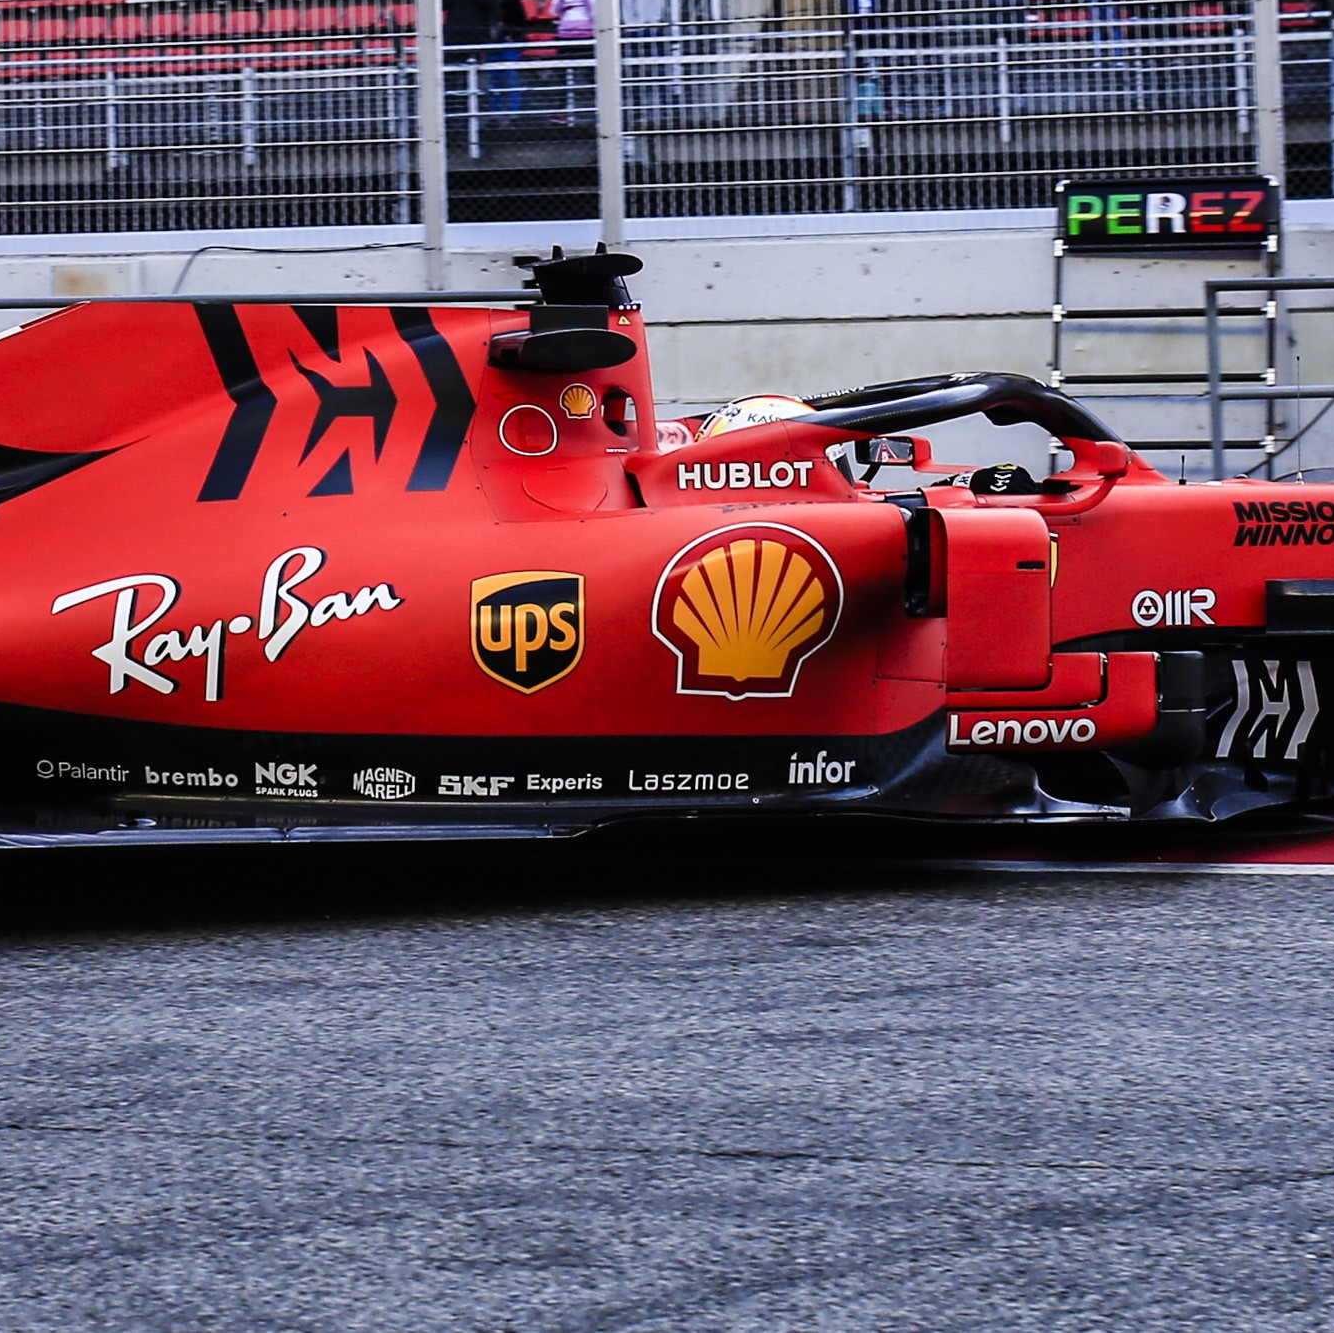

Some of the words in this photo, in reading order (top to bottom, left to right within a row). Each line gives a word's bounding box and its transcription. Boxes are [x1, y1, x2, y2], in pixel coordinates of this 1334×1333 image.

[1067, 190, 1266, 236] PEREZ
[677, 460, 815, 491] HUBLOT
[479, 602, 578, 673] ups
[947, 713, 1097, 747] Lenovo
[58, 762, 131, 784] Palantir
[144, 765, 239, 788] brembo
[254, 762, 319, 787] NGK
[788, 750, 857, 785] infor
[437, 774, 515, 797] SKF
[526, 773, 603, 793] Experis
[628, 769, 750, 792] Laszmoe
[255, 787, 286, 797] SPARK
[287, 788, 320, 799] PLUGS
